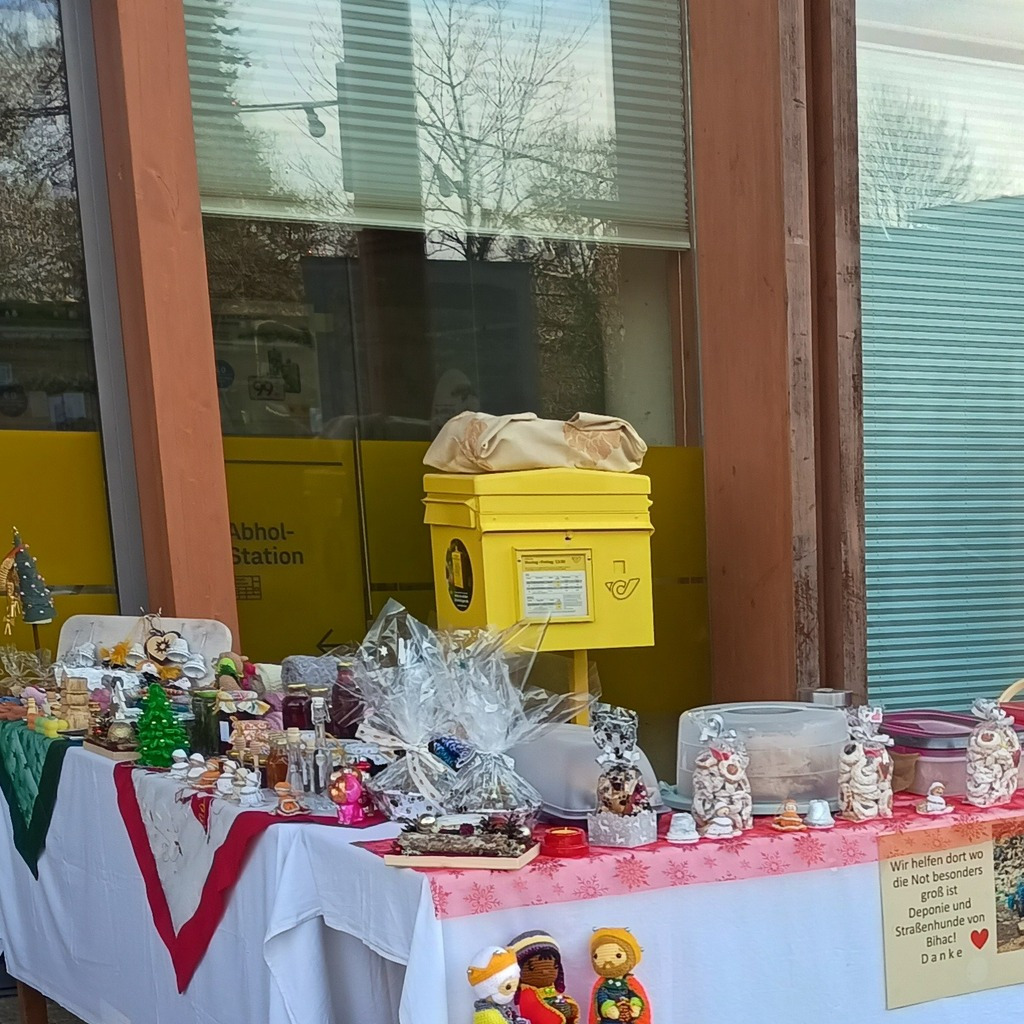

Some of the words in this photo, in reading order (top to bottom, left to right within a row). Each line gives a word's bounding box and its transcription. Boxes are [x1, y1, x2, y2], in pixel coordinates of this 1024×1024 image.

[230, 522, 294, 540] Abhol-
[232, 546, 304, 564] Station
[890, 860, 909, 872] Wir
[912, 856, 943, 869] helfen
[946, 852, 967, 864] dort
[969, 850, 984, 860] wo
[893, 877, 909, 888] die
[911, 873, 930, 885] Not
[932, 866, 983, 882] besonders
[921, 886, 944, 903] groß
[947, 885, 958, 896] ist
[909, 903, 950, 919] Deponie
[953, 898, 972, 911] und
[896, 916, 965, 937] Straßenhunde
[967, 914, 985, 924] von
[927, 932, 957, 948] Bihac!
[921, 949, 963, 964] Danke
